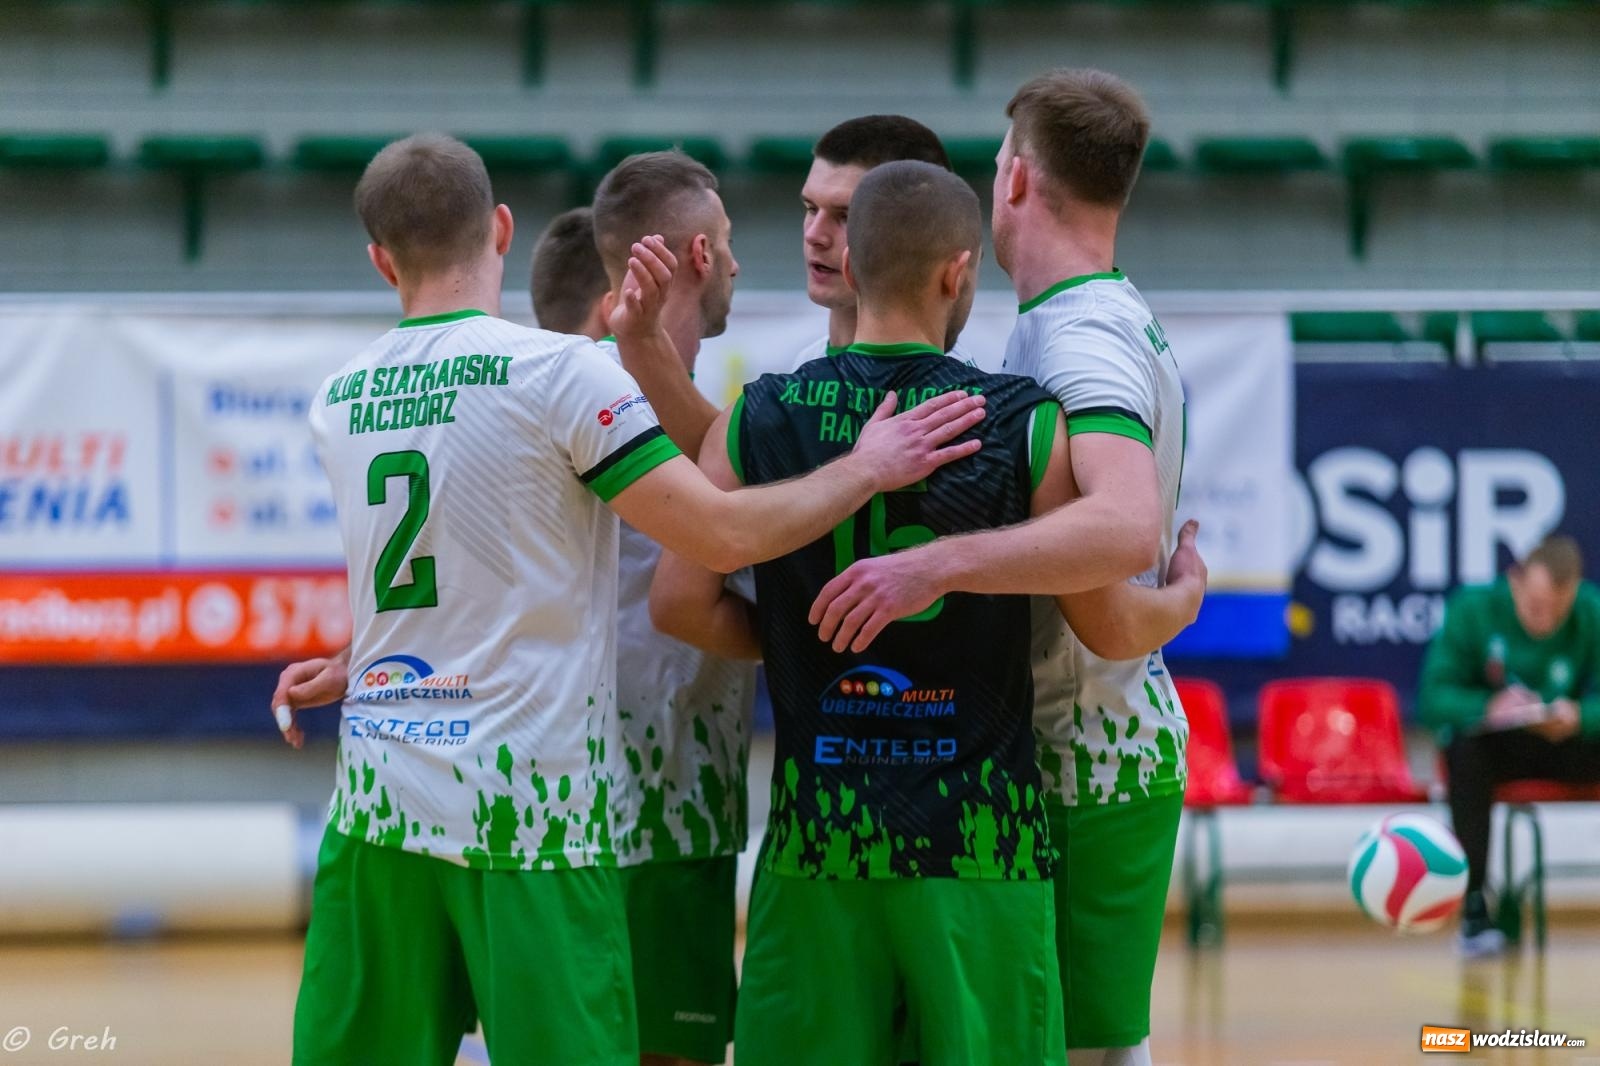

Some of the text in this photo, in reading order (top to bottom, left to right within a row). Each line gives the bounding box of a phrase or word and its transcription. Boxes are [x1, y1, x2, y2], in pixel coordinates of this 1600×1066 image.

[326, 354, 513, 407] KLUB SIATKARSKI
[780, 380, 840, 407] KLUB
[349, 390, 458, 435] RACIBÓRZ
[367, 449, 438, 613] 2
[1293, 446, 1567, 593] SiR
[420, 675, 469, 687] MULTI
[902, 689, 955, 702] MULTI
[821, 698, 956, 718] UBEZPIECZENIA
